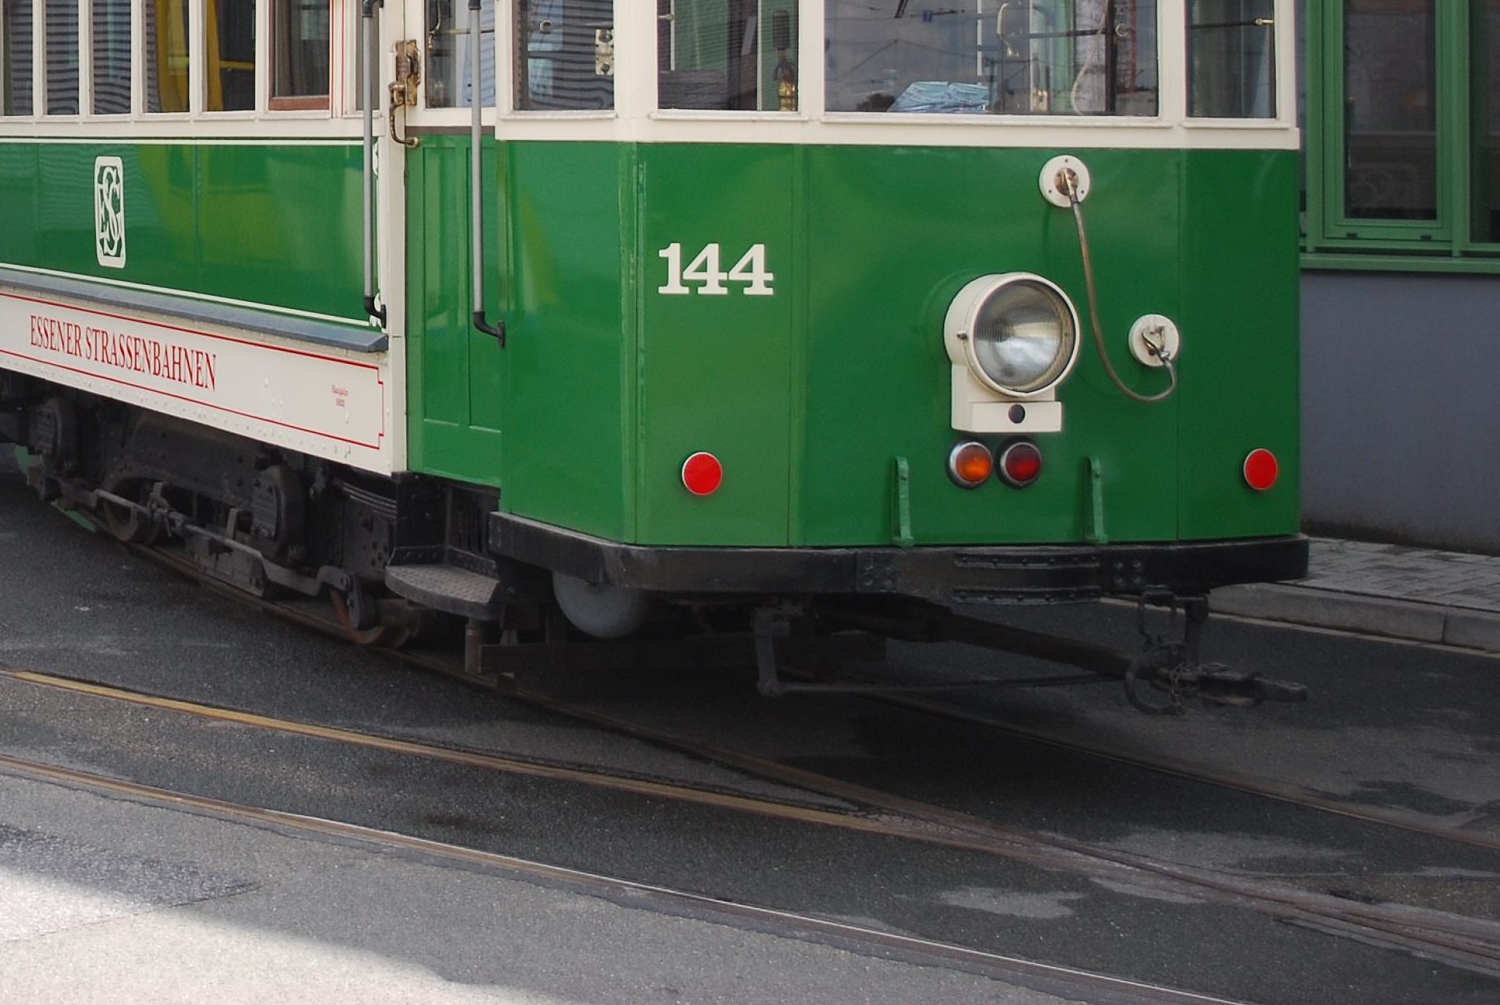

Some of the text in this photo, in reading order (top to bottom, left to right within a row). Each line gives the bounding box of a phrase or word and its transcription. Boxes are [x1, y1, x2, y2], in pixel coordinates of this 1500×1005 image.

[657, 242, 775, 296] 144
[30, 315, 217, 391] ESSENER STRASSENBAHNEN
